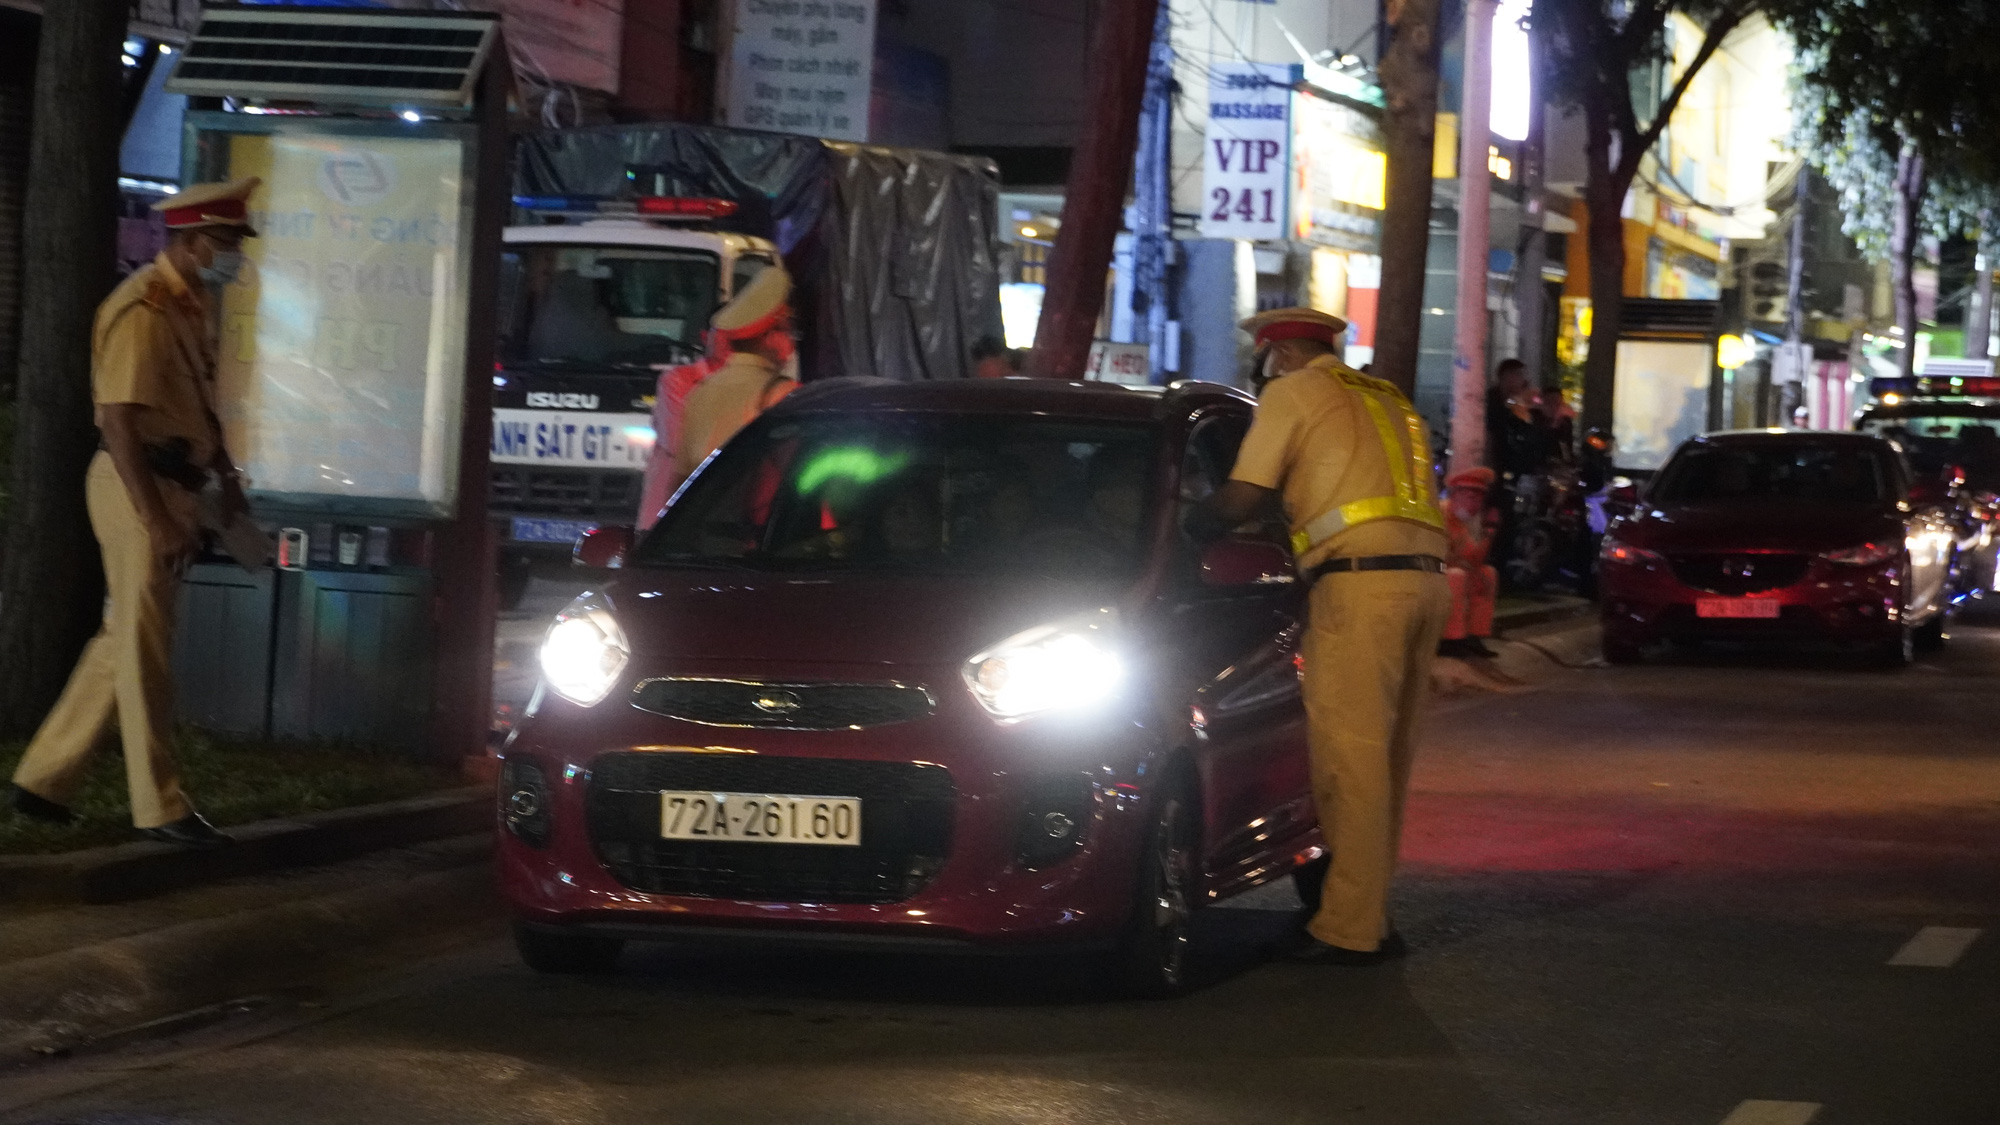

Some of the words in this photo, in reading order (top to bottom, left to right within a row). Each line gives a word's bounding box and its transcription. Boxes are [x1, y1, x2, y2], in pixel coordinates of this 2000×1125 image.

[744, 104, 775, 126] GPS
[1210, 103, 1284, 120] MASSAGE
[1213, 139, 1280, 173] VIP
[1211, 187, 1275, 223] 241
[527, 392, 599, 410] ISUZU
[535, 414, 575, 459] SÁT
[669, 797, 851, 839] 72A-261.60
